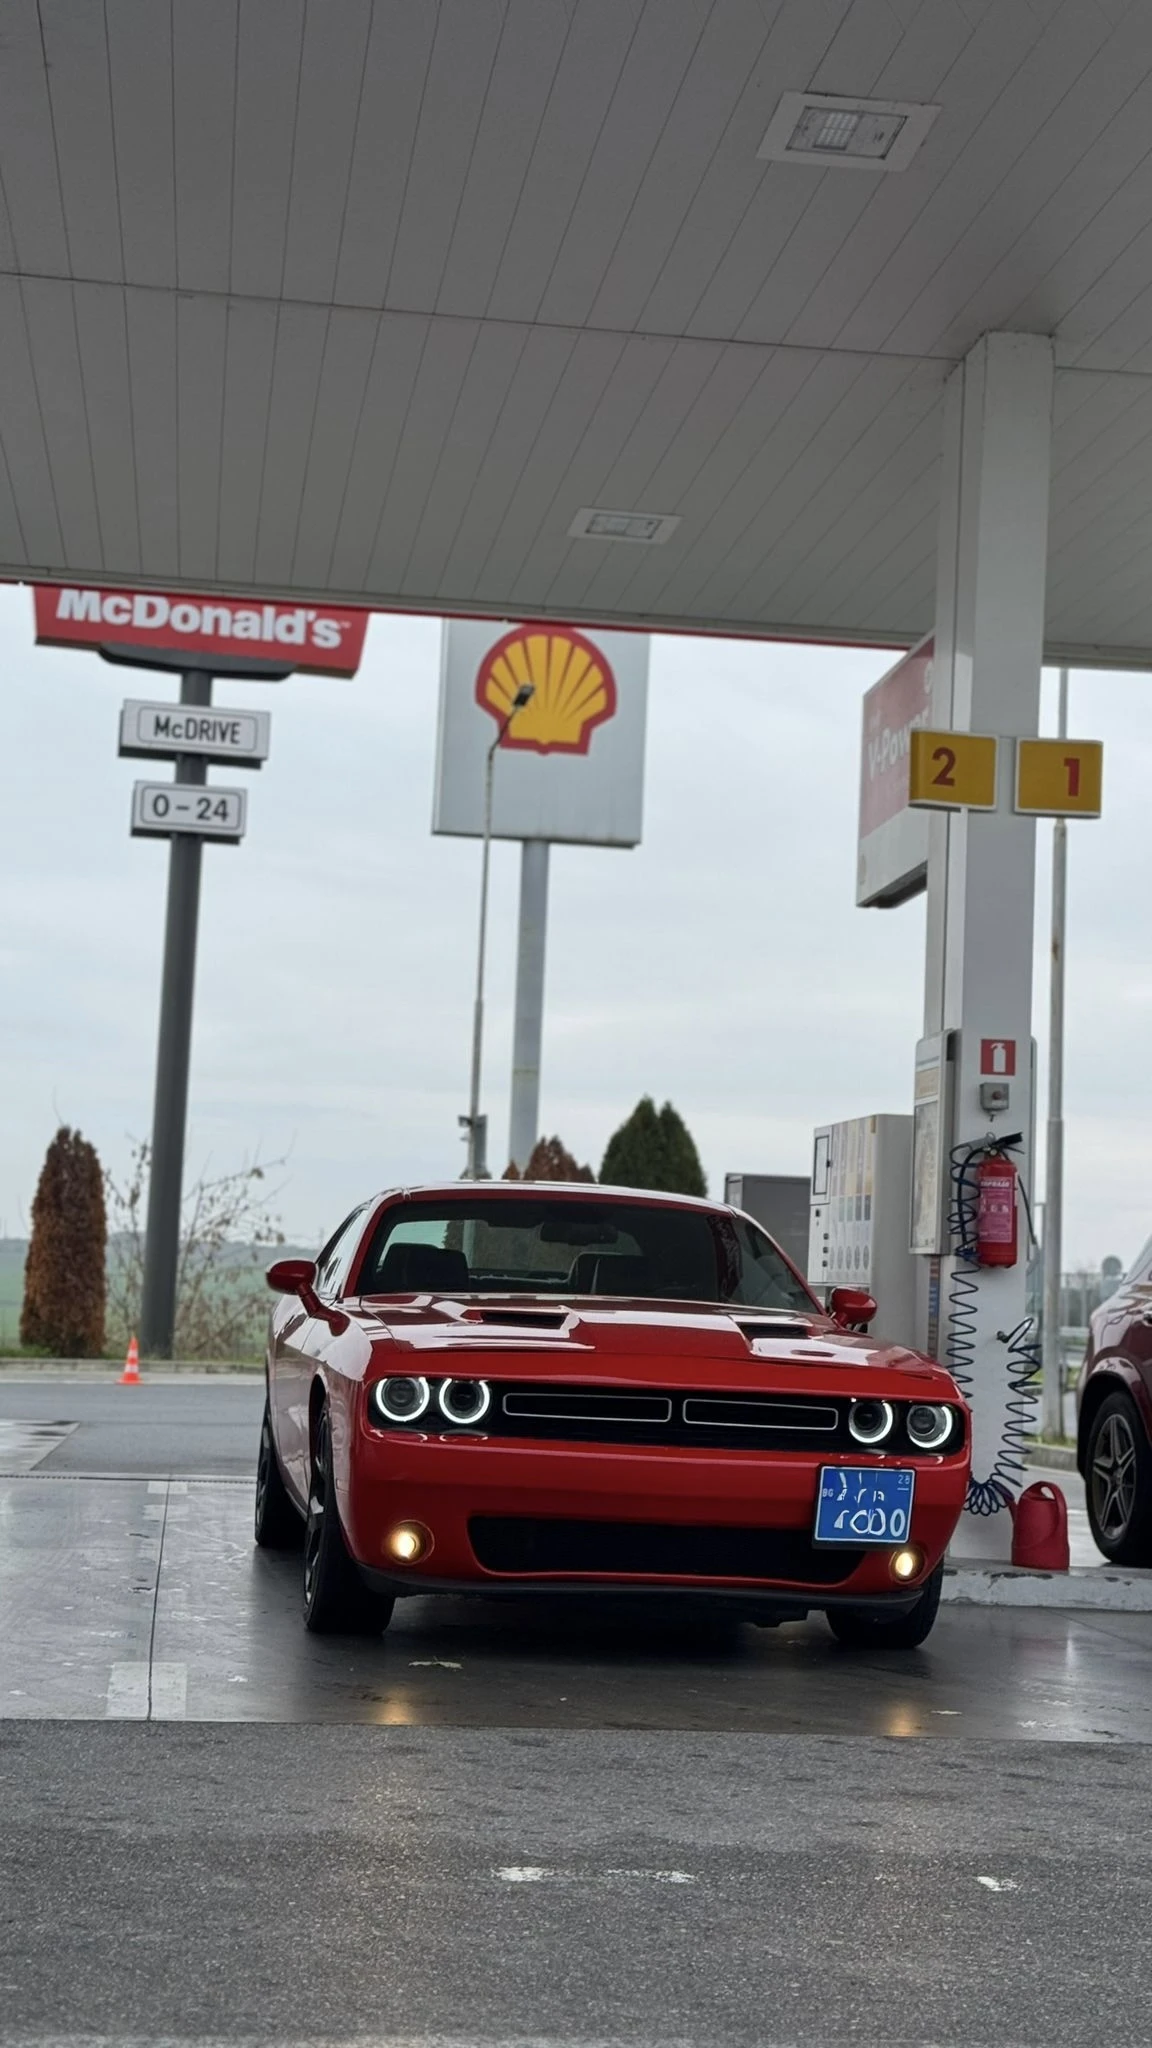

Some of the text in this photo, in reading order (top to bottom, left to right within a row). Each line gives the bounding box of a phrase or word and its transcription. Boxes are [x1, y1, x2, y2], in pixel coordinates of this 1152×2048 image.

[56, 589, 341, 648] McDonald's
[153, 715, 241, 744] McDRIVE
[931, 747, 956, 787] 2
[1064, 758, 1080, 797] 1
